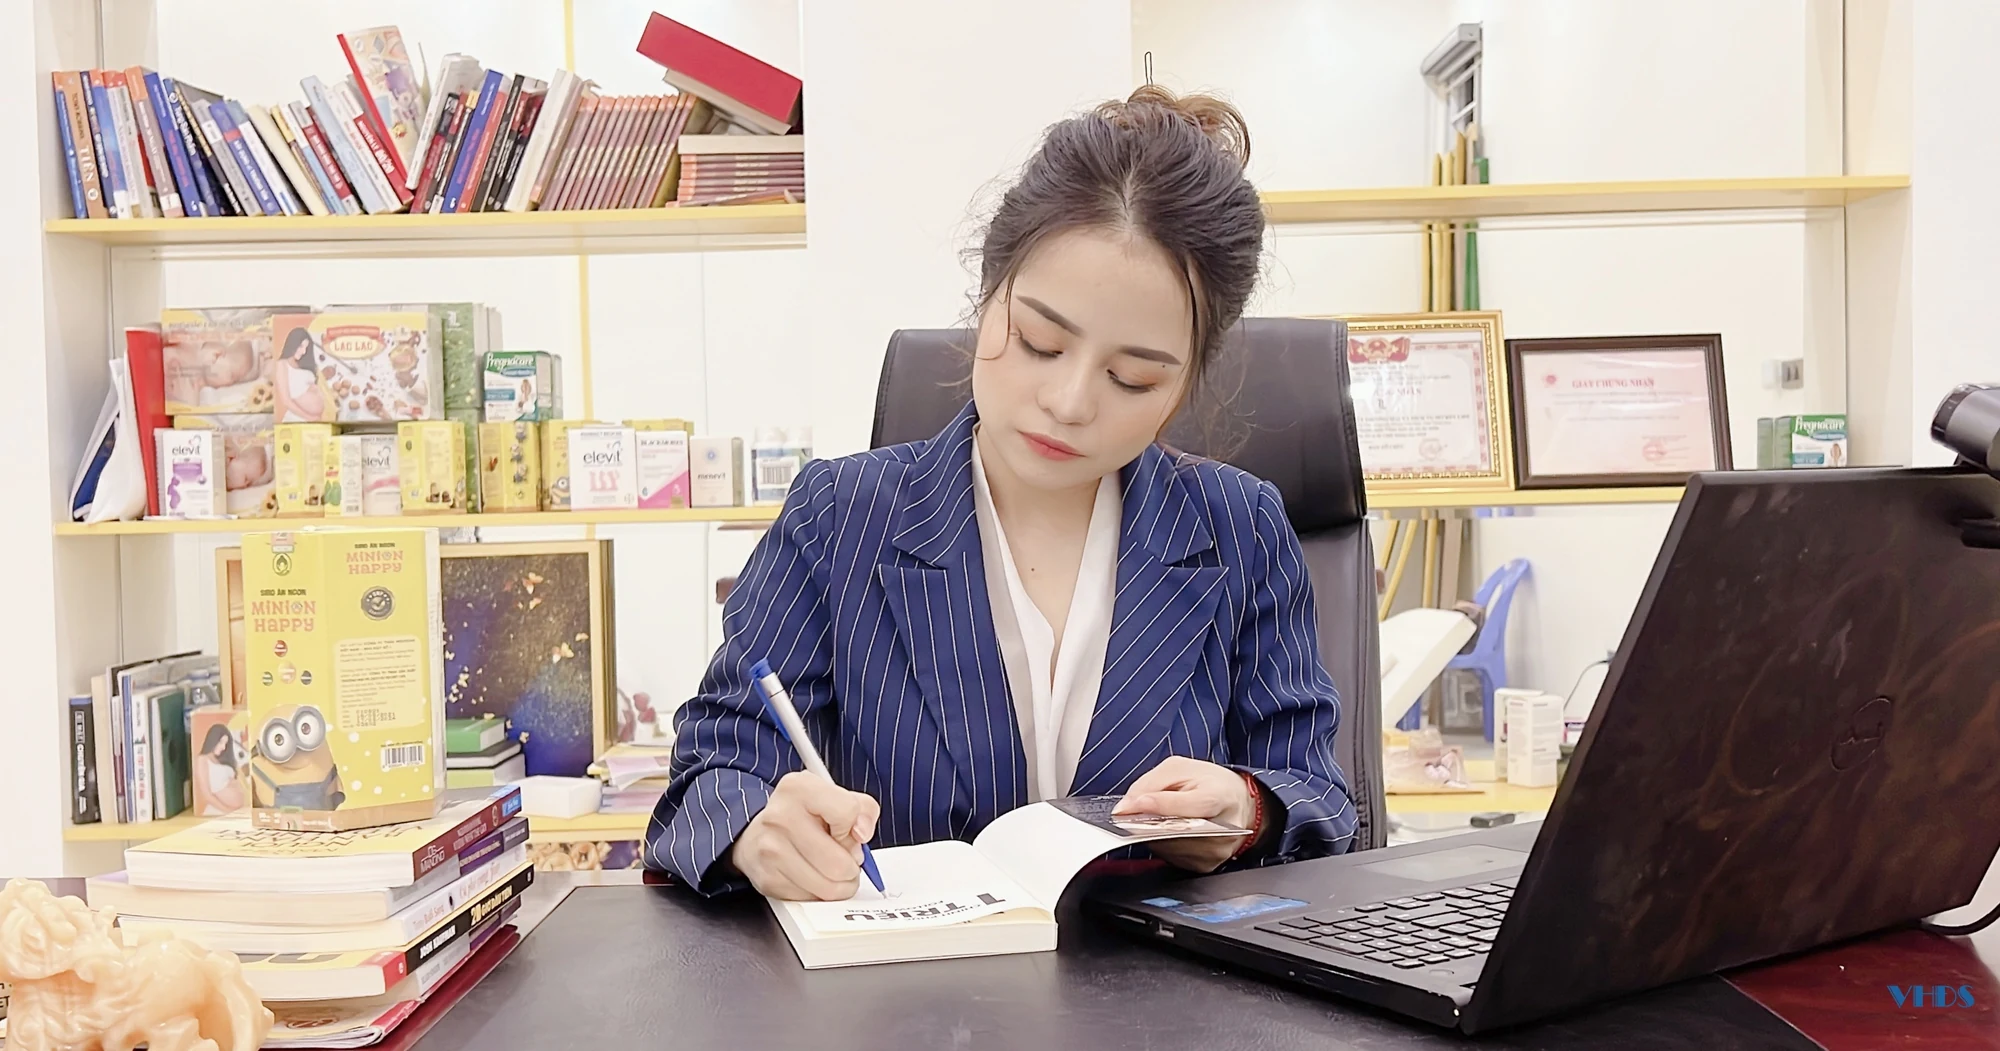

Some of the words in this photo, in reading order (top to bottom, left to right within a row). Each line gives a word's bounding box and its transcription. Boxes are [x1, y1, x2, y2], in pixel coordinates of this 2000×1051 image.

[486, 352, 535, 371] Pregnacare
[1795, 415, 1845, 435] Pregnacare
[171, 445, 200, 456] elevit
[583, 450, 621, 464] elevit
